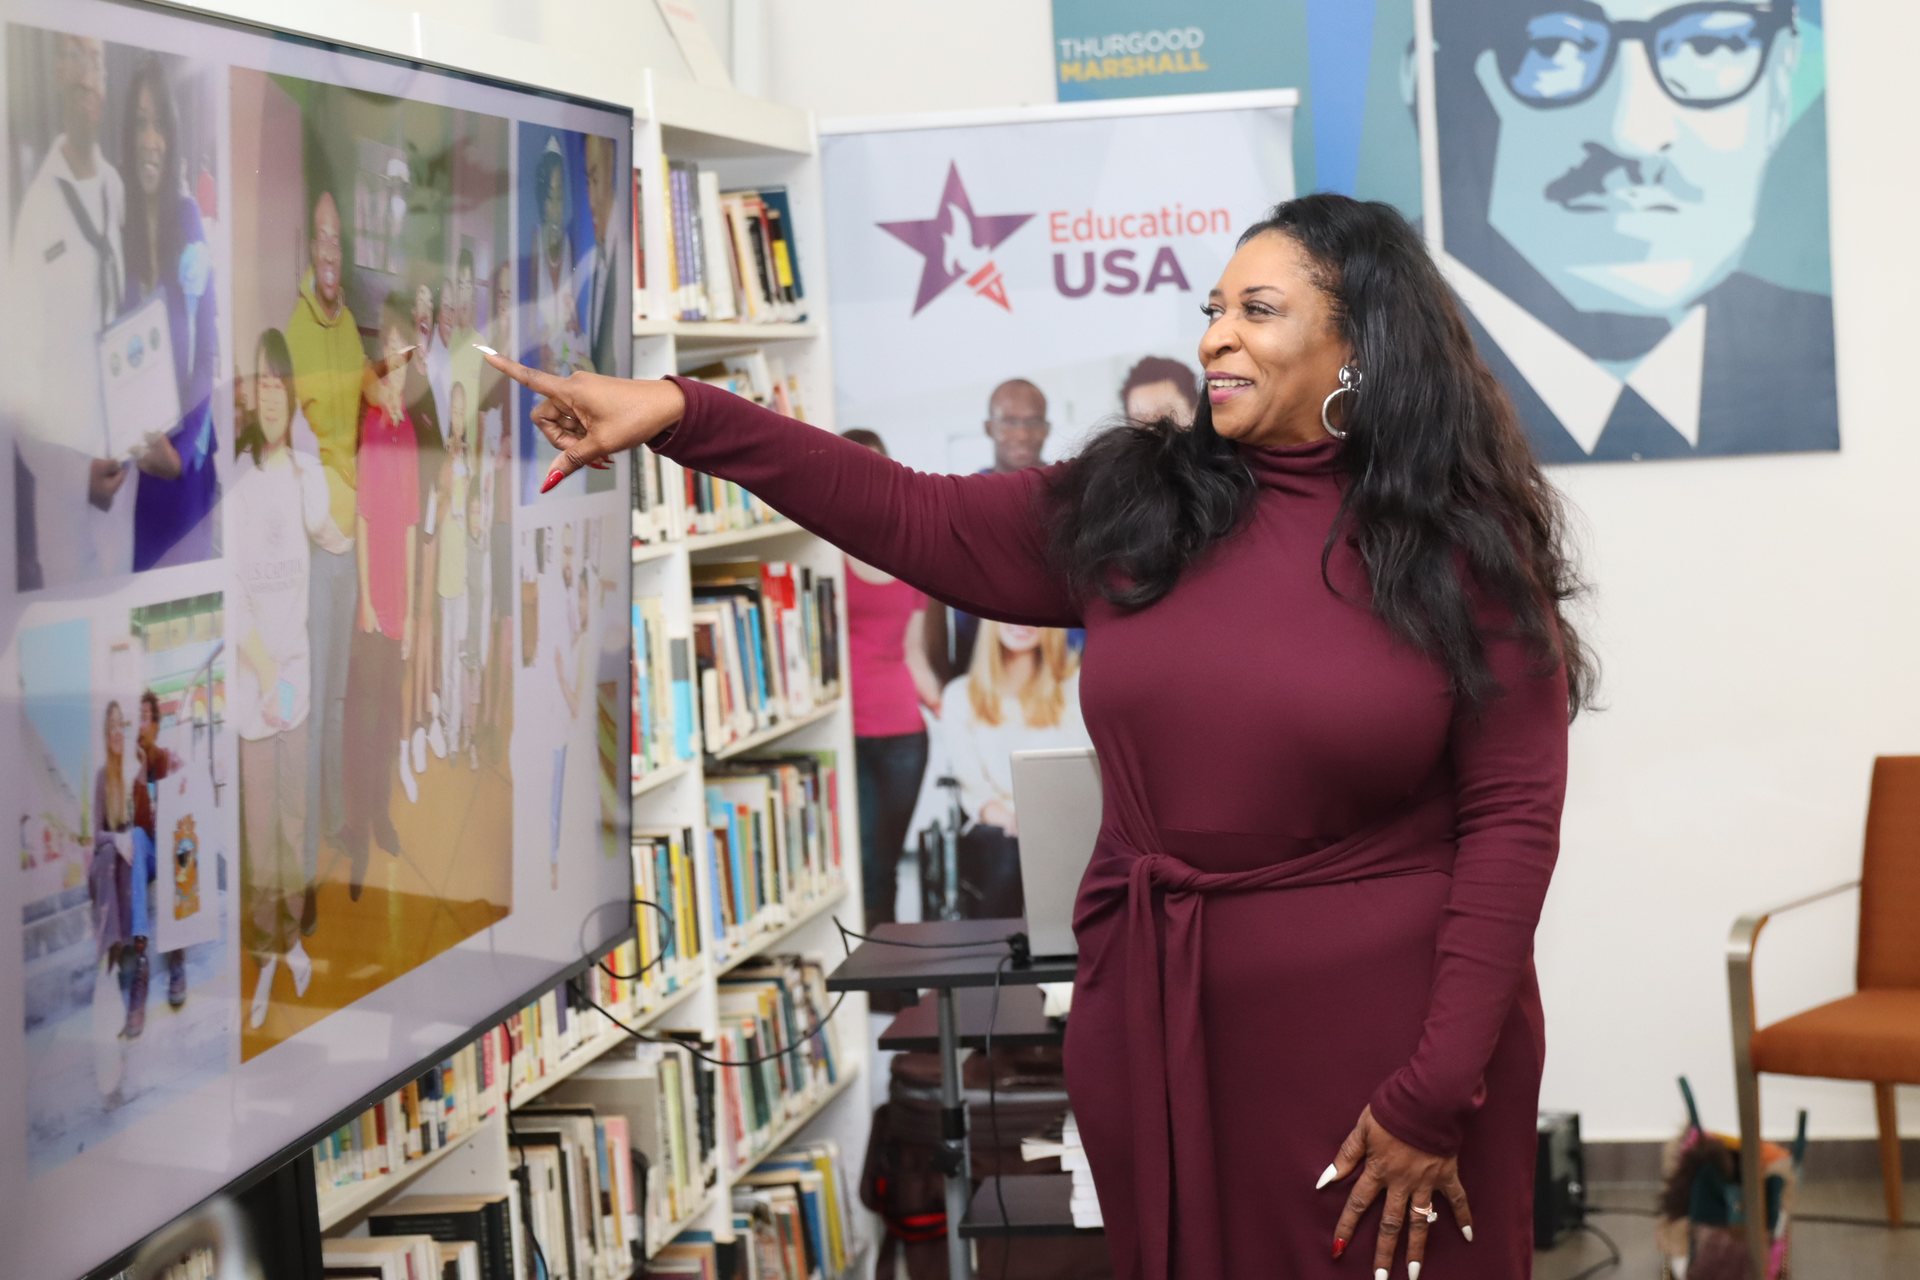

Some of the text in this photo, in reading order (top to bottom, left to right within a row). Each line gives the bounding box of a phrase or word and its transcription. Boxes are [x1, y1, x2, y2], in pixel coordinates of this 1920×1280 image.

[1059, 27, 1205, 58] THURGOOD
[1061, 51, 1208, 82] MARSHALL
[1049, 203, 1231, 243] Education
[1053, 246, 1191, 299] USA
